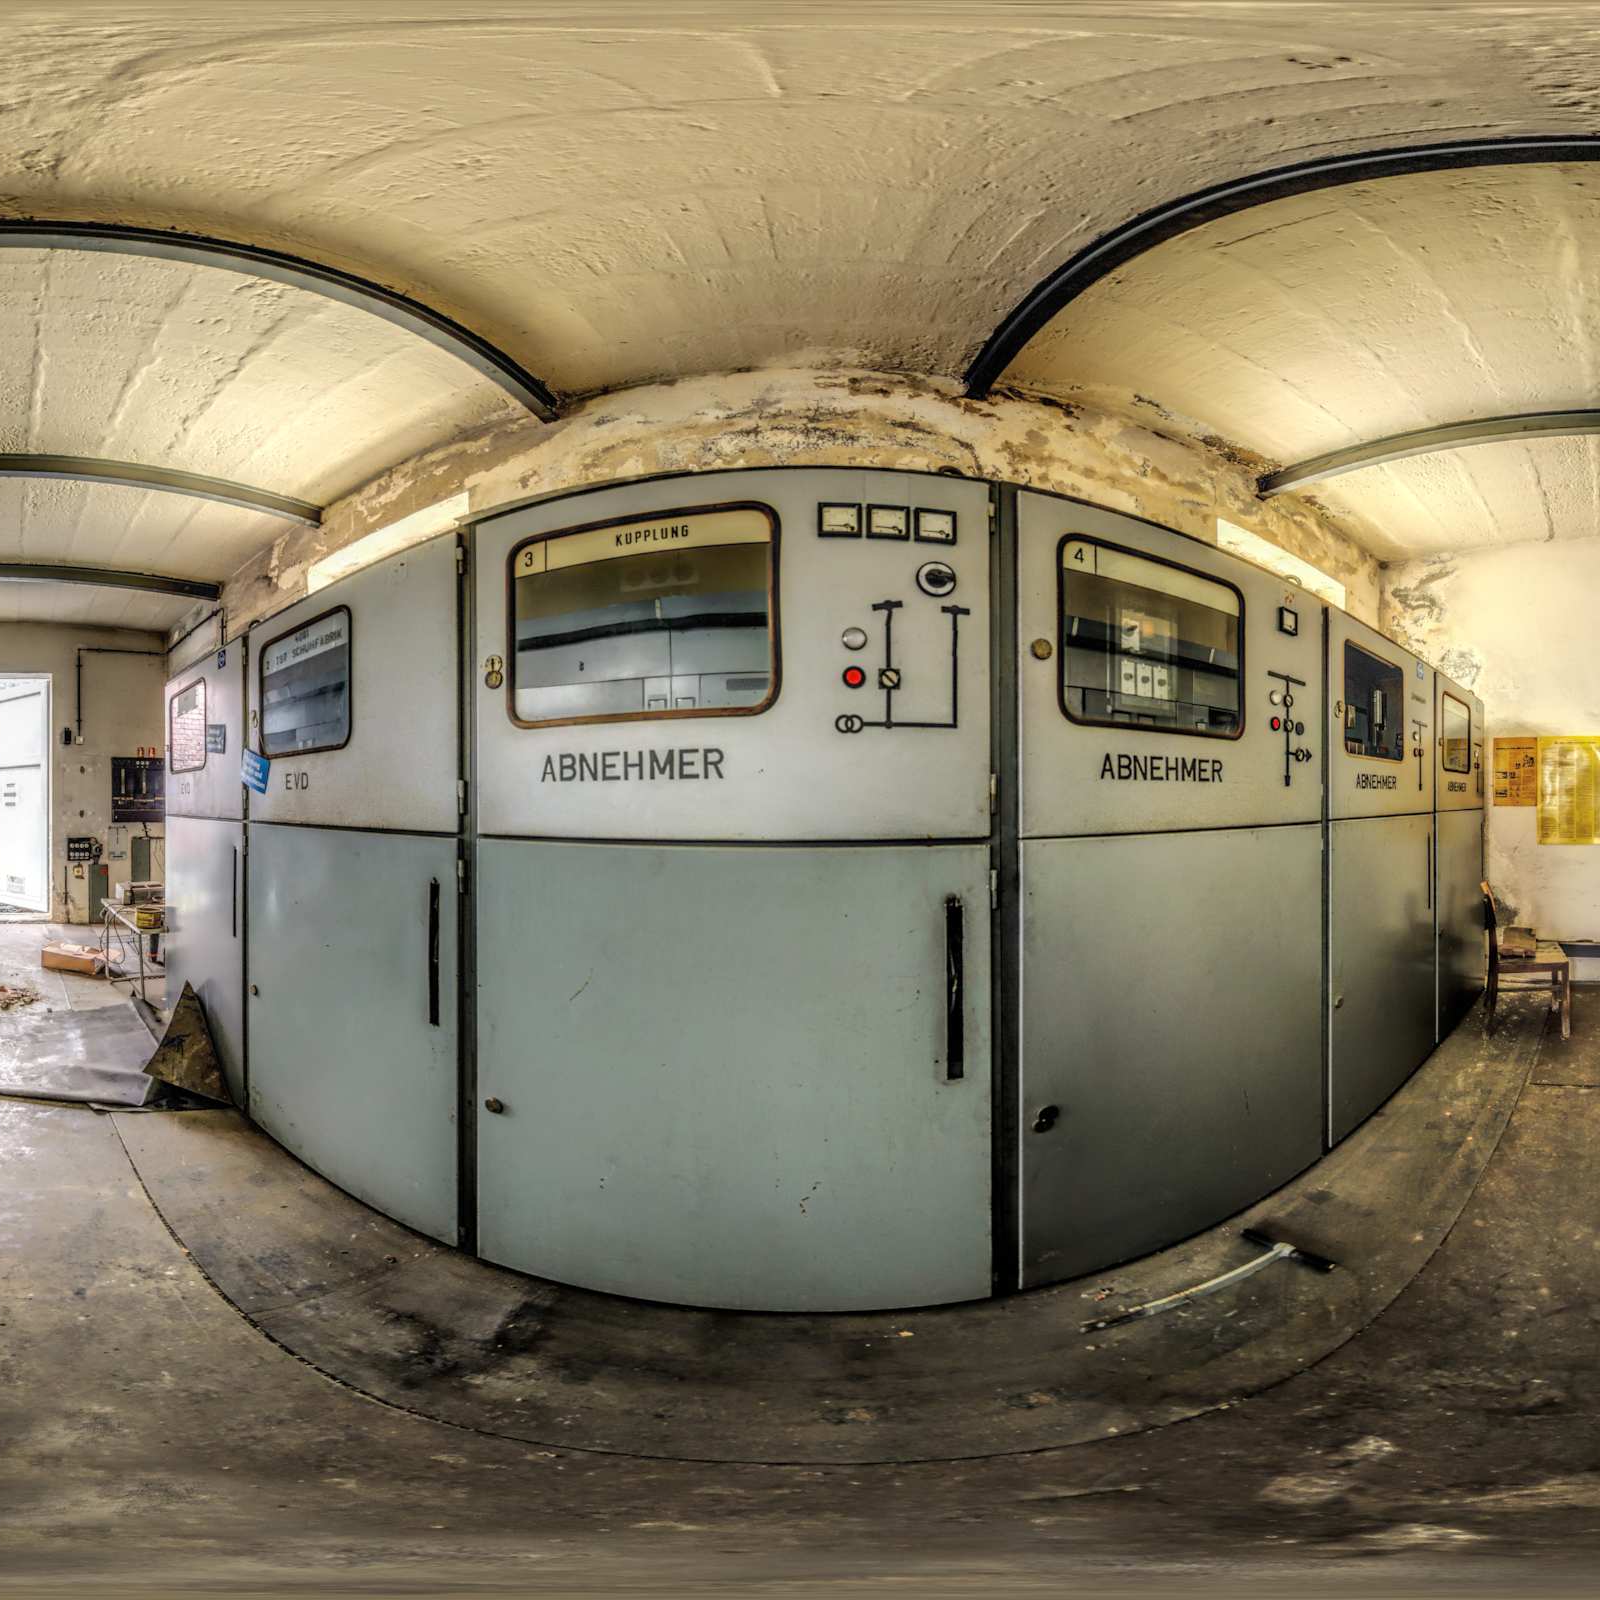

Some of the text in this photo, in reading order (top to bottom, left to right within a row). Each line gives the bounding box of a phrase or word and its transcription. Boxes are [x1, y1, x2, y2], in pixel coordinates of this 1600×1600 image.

[615, 525, 689, 546] KUPPLUNG
[524, 552, 533, 567] 3
[1074, 547, 1084, 563] 4
[541, 748, 724, 782] ABNEHMER
[1100, 753, 1223, 782] ABNEHMER
[285, 772, 309, 790] EVD
[1356, 772, 1397, 790] ABNEHMER
